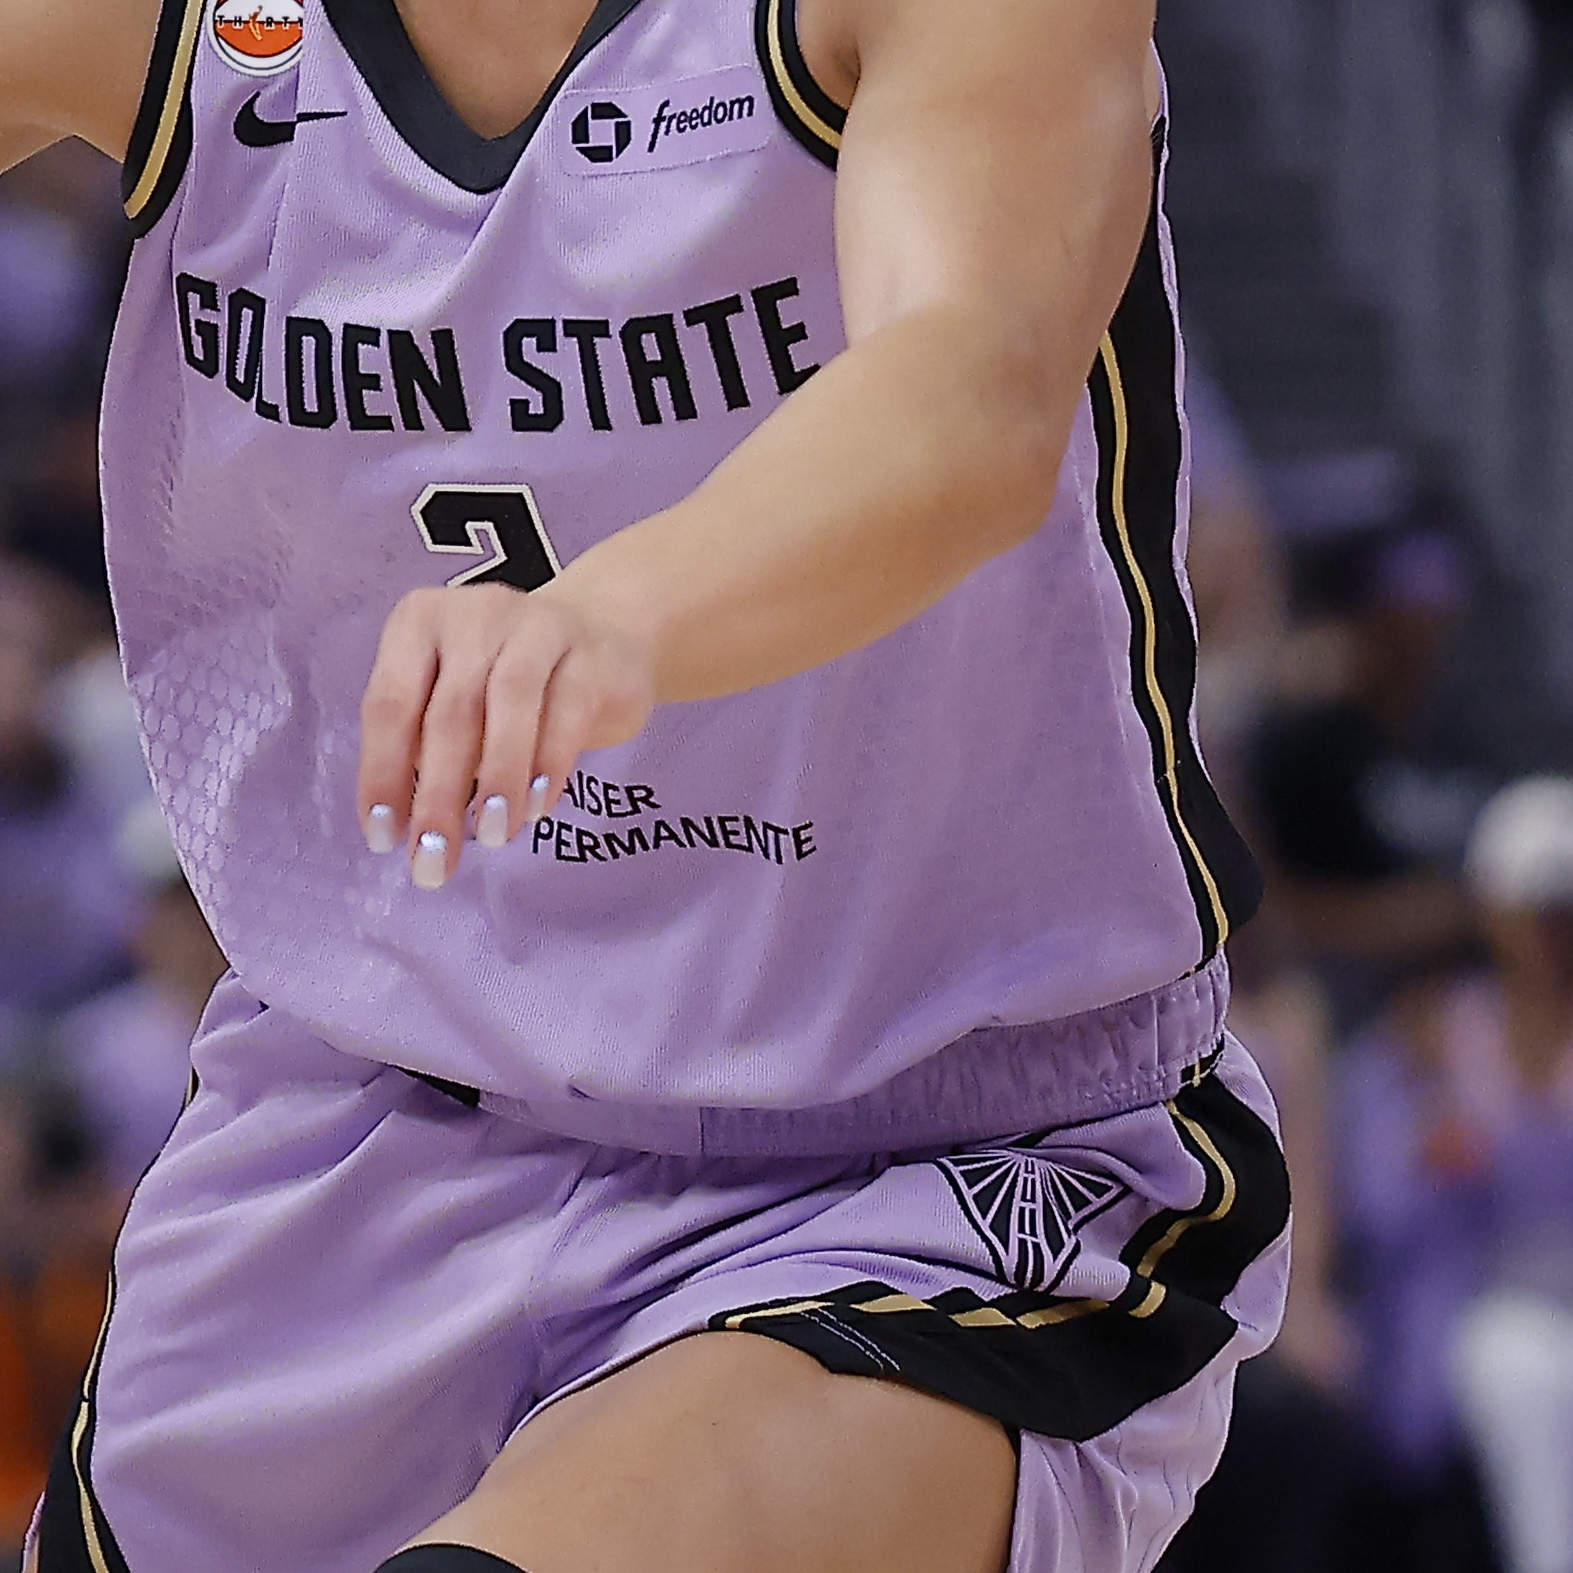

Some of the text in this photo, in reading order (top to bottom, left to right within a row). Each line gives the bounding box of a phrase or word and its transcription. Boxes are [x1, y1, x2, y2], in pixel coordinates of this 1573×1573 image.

[646, 92, 755, 152] freedom
[175, 272, 821, 432] GOLDEN STATE
[562, 769, 662, 819] AISER
[531, 815, 818, 865] PERMANENTE
